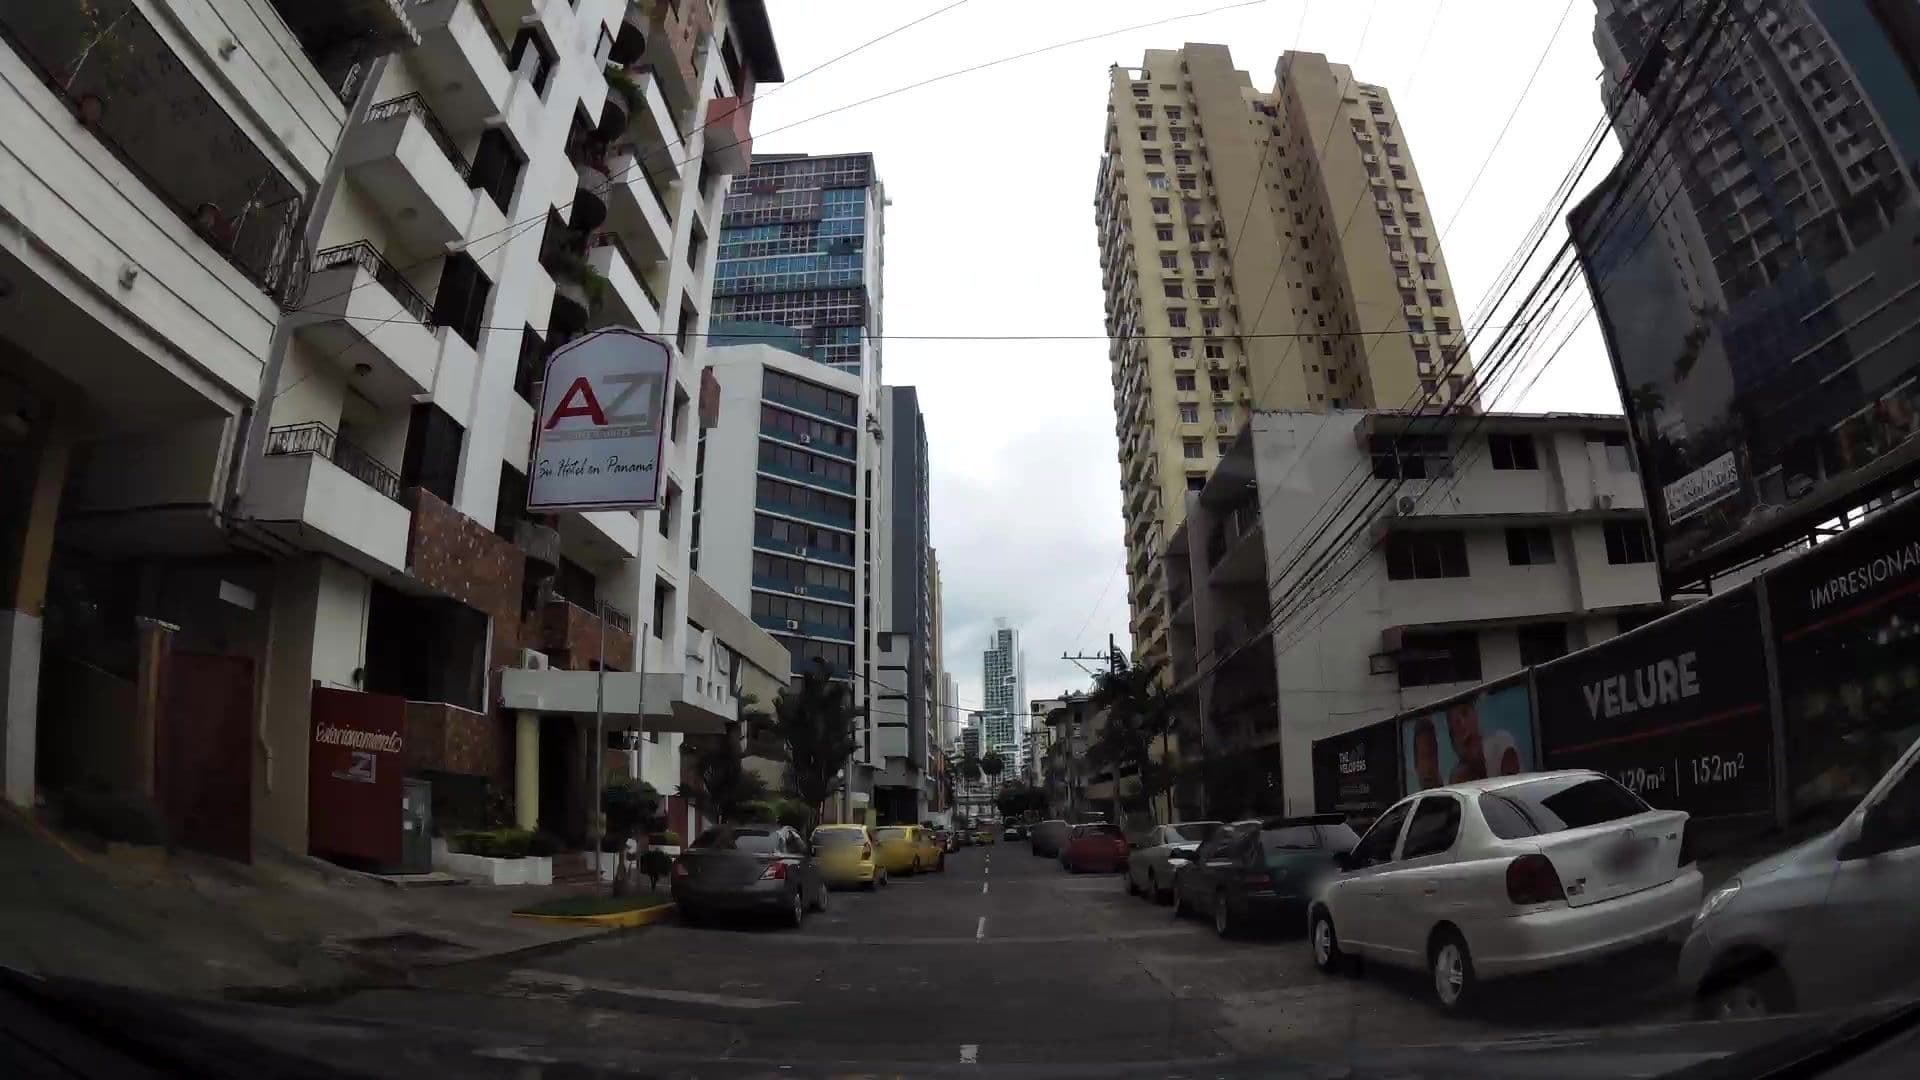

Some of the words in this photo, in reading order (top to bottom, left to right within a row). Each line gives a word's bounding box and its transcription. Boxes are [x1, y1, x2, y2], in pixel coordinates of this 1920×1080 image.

[557, 457, 587, 478] Hotel
[588, 466, 601, 475] en
[606, 455, 654, 474] Panamá
[1583, 651, 1700, 720] VELURE
